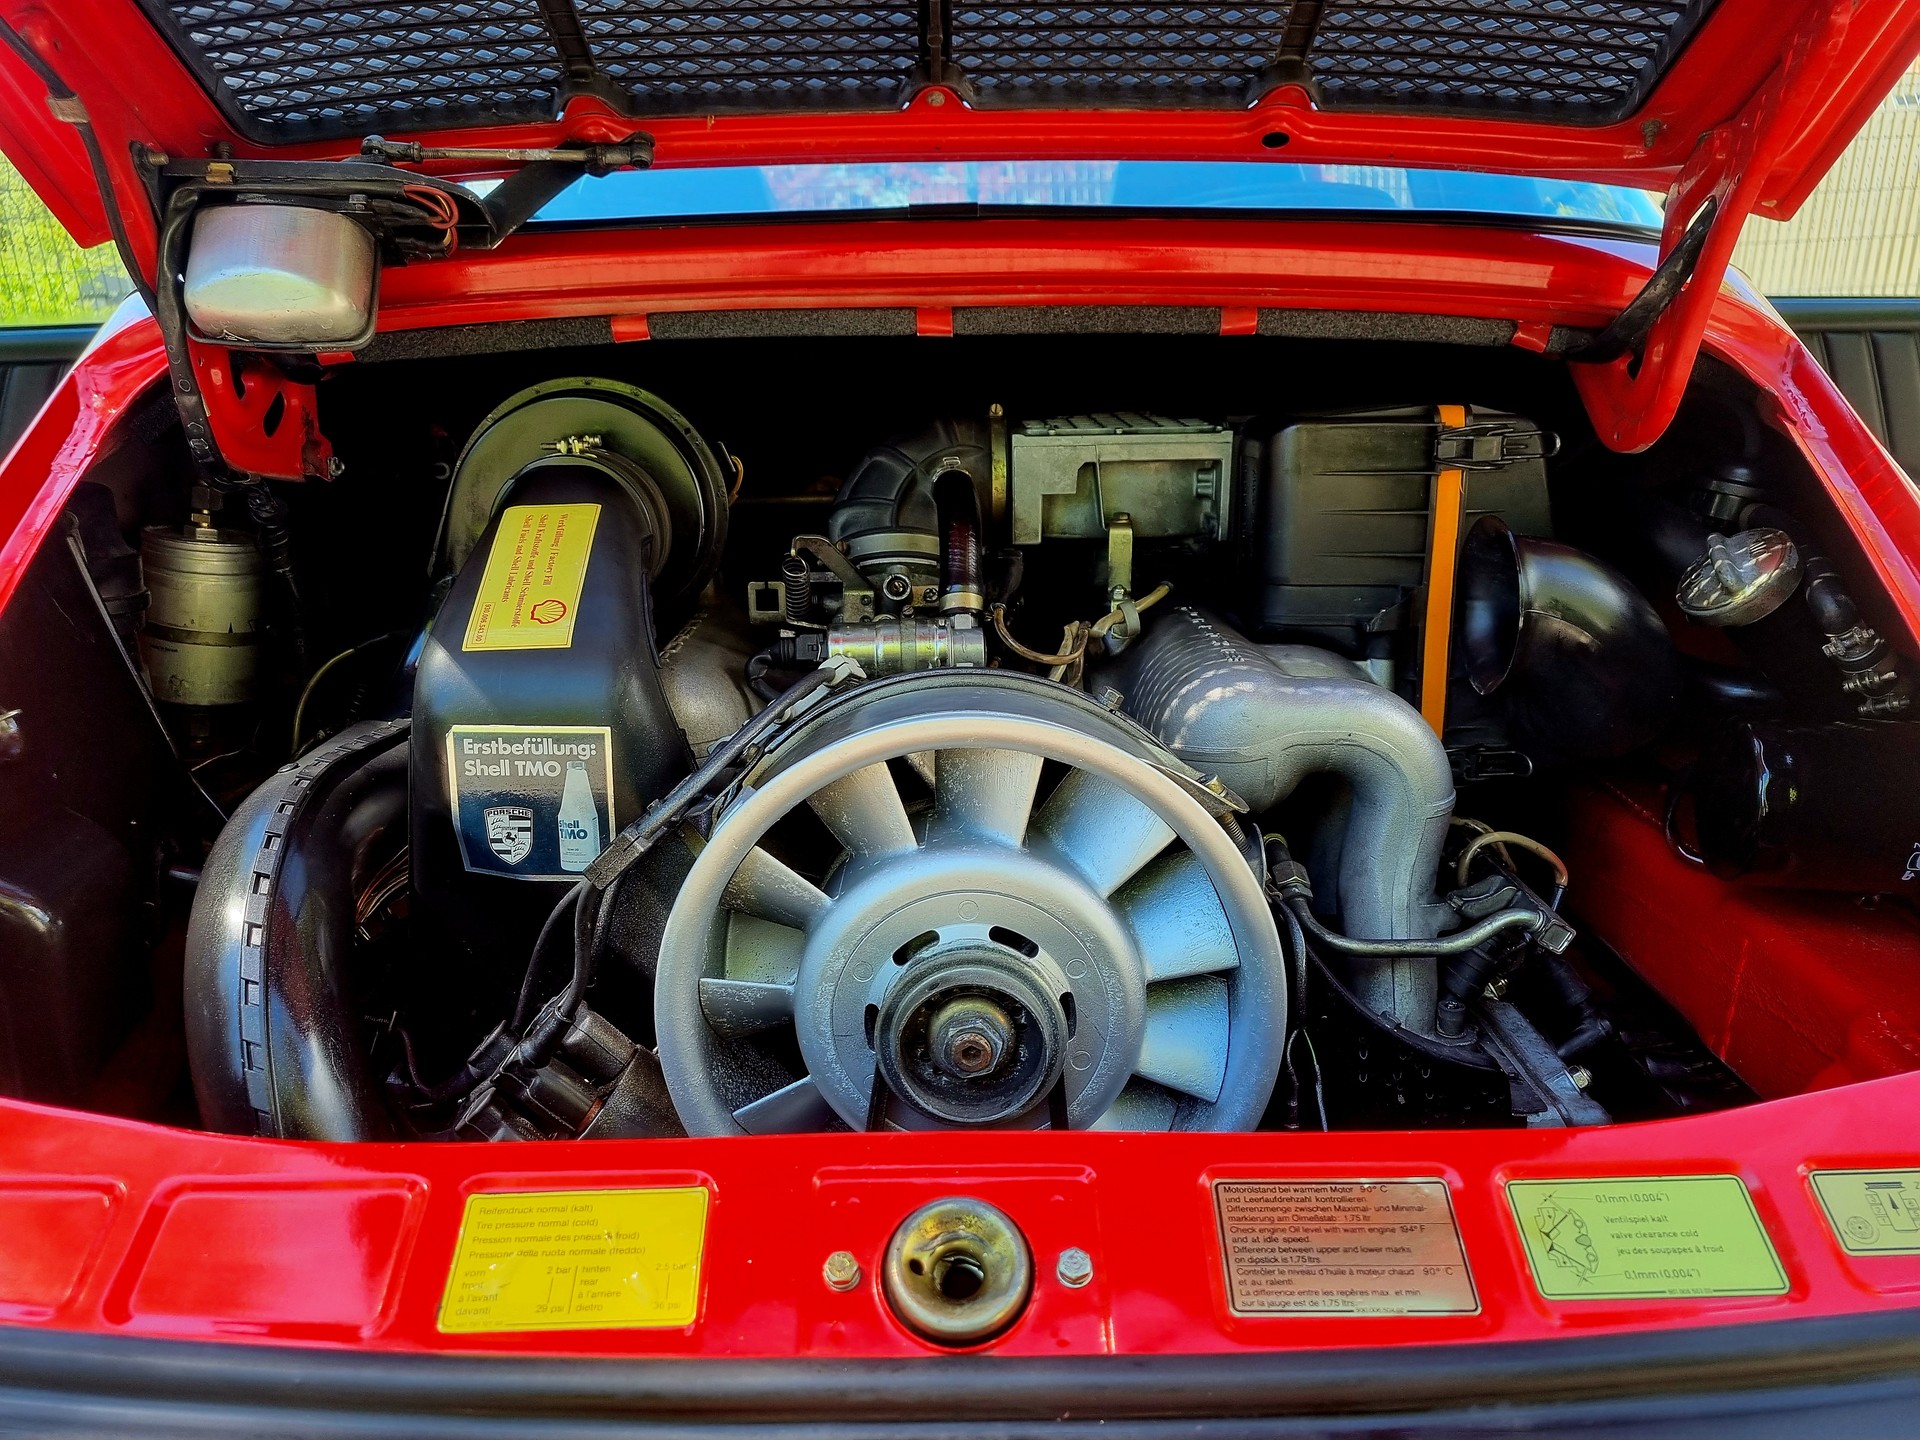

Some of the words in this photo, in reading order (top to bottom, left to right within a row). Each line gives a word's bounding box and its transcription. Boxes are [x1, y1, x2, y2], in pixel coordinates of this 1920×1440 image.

[523, 514, 533, 529] Shell
[538, 514, 549, 528] Shell
[550, 514, 568, 547] Werkfüllung
[518, 529, 530, 544] Fuels
[530, 529, 545, 558] Kraftstoffe
[515, 546, 524, 555] and
[511, 556, 522, 571] Shell
[527, 560, 535, 570] und
[544, 552, 559, 574] Factory
[522, 571, 534, 585] Shell
[543, 575, 553, 586] Fill
[502, 572, 517, 603] Lubricants
[511, 587, 529, 628] Schmierstoffe
[463, 737, 597, 760] Erstbefüllung:
[464, 759, 510, 777] Shell
[515, 760, 561, 777] TMO
[487, 809, 530, 817] PORSCHE
[559, 820, 579, 828] Shell
[560, 829, 588, 840] TMO
[1380, 1185, 1388, 1193] C
[480, 1206, 533, 1215] Reifendruck
[537, 1205, 568, 1213] normal
[572, 1204, 593, 1213] (kalt)
[1227, 1205, 1292, 1214] Differenzmenge
[477, 1221, 493, 1230] Tire
[495, 1222, 535, 1230] pressure
[572, 1218, 598, 1227] (cold)
[1228, 1215, 1274, 1223] markierung
[1604, 1215, 1649, 1224] Ventilspiel
[1650, 1215, 1669, 1223] kalt
[1258, 1226, 1288, 1235] engine
[1289, 1225, 1301, 1233] Oil
[1367, 1226, 1396, 1235] engine
[1420, 1225, 1426, 1233] F
[1610, 1231, 1633, 1239] valve
[1635, 1230, 1679, 1238] clearance
[1681, 1229, 1699, 1237] cold
[473, 1236, 512, 1244] Pression
[514, 1235, 552, 1243] normale
[555, 1233, 571, 1241] des
[573, 1233, 602, 1242] pneus
[615, 1232, 640, 1240] froid)
[469, 1251, 514, 1259] Pressione
[542, 1249, 566, 1257] ruota
[568, 1248, 606, 1256] normale
[609, 1247, 646, 1256] (freddo)
[1316, 1247, 1340, 1255] upper
[1617, 1248, 1631, 1257] jeu
[1633, 1247, 1648, 1255] des
[1650, 1247, 1693, 1256] soupapes
[1703, 1245, 1725, 1253] froid
[1247, 1256, 1279, 1264] dipstick
[464, 1269, 486, 1278] vorn
[547, 1266, 553, 1274] 2
[556, 1266, 571, 1274] bar
[582, 1265, 611, 1273] hinten
[673, 1262, 688, 1270] bar
[1445, 1267, 1453, 1275] C
[580, 1278, 598, 1286] rear
[576, 1303, 603, 1312] dietro
[667, 1302, 681, 1310] psi
[1256, 1299, 1265, 1307] la
[1267, 1299, 1291, 1308] jauge
[456, 1308, 491, 1316] davanti
[536, 1304, 548, 1313] 29
[550, 1305, 564, 1314] psi
